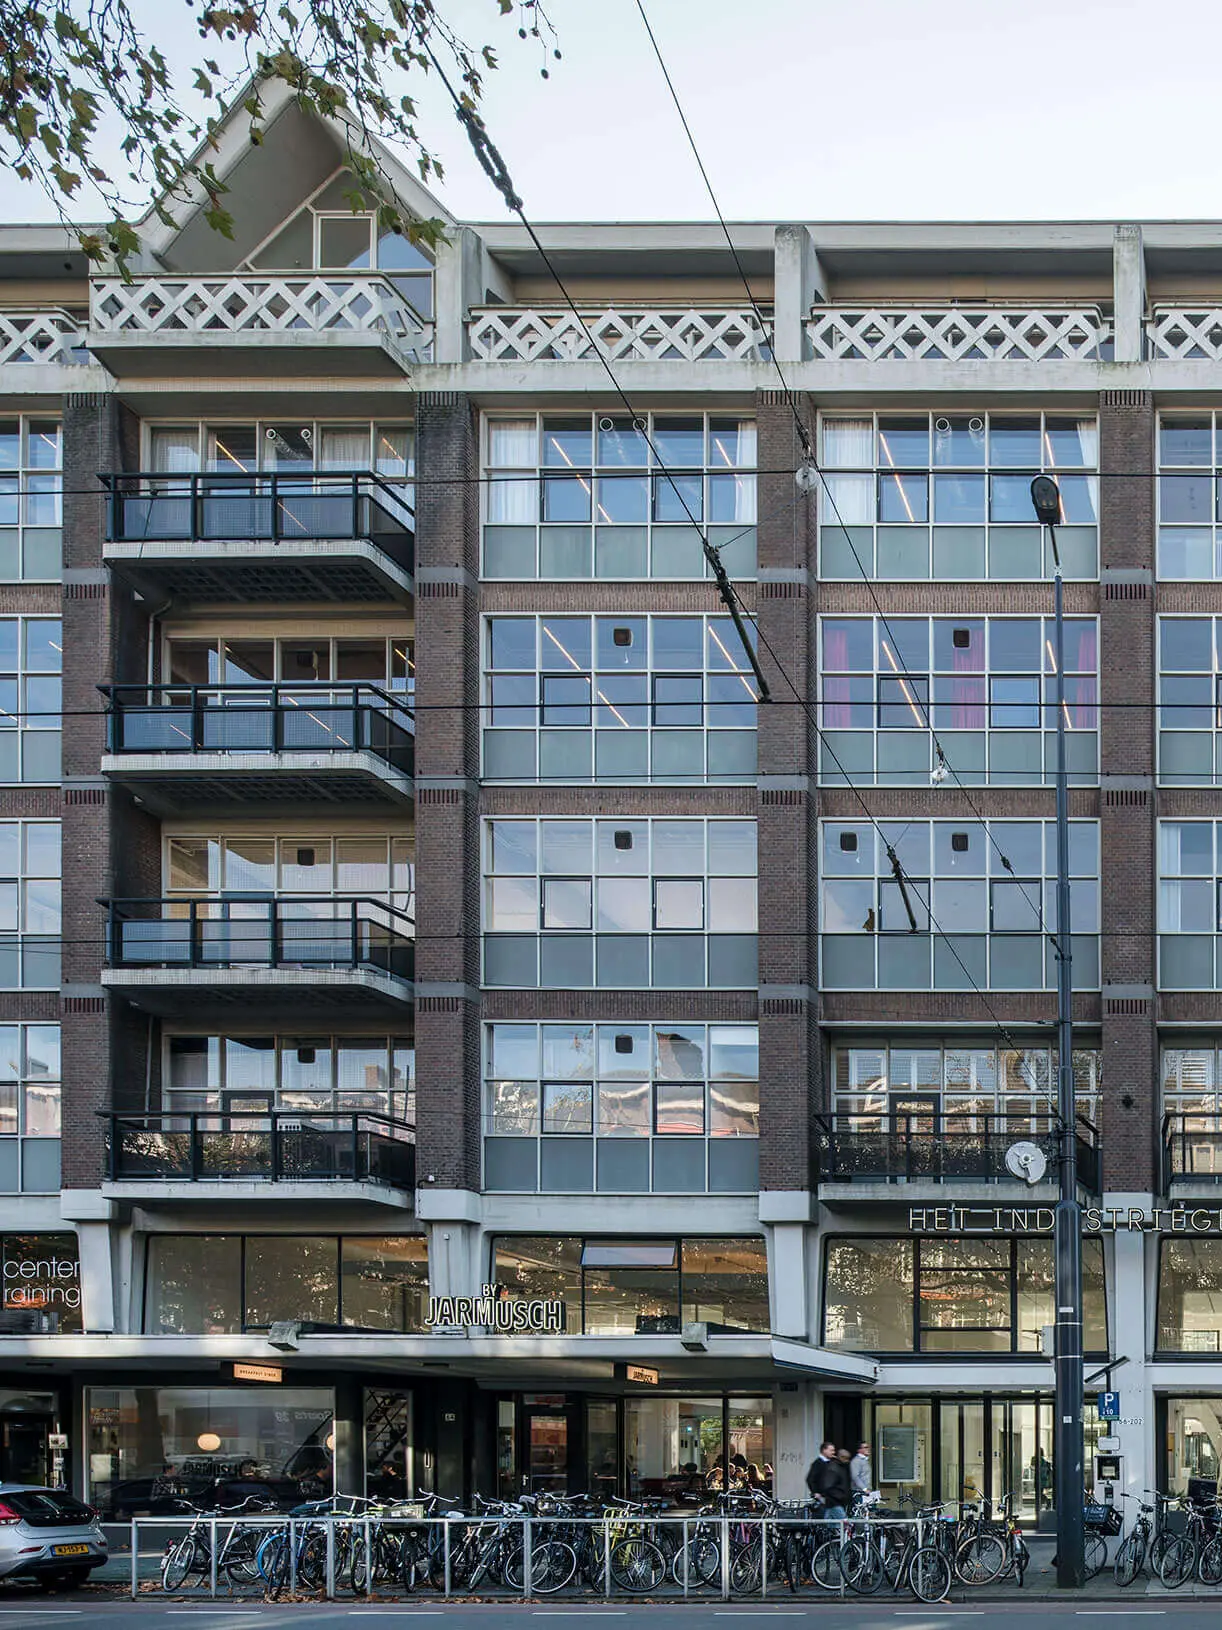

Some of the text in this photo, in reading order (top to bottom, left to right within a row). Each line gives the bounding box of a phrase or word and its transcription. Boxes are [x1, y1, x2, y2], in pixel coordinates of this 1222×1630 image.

[908, 1207, 970, 1231] HET
[3, 1256, 81, 1279] center
[4, 1283, 81, 1308] raining
[482, 1284, 498, 1297] BY
[424, 1296, 563, 1330] JARMUSCH
[1104, 1393, 1114, 1407] P
